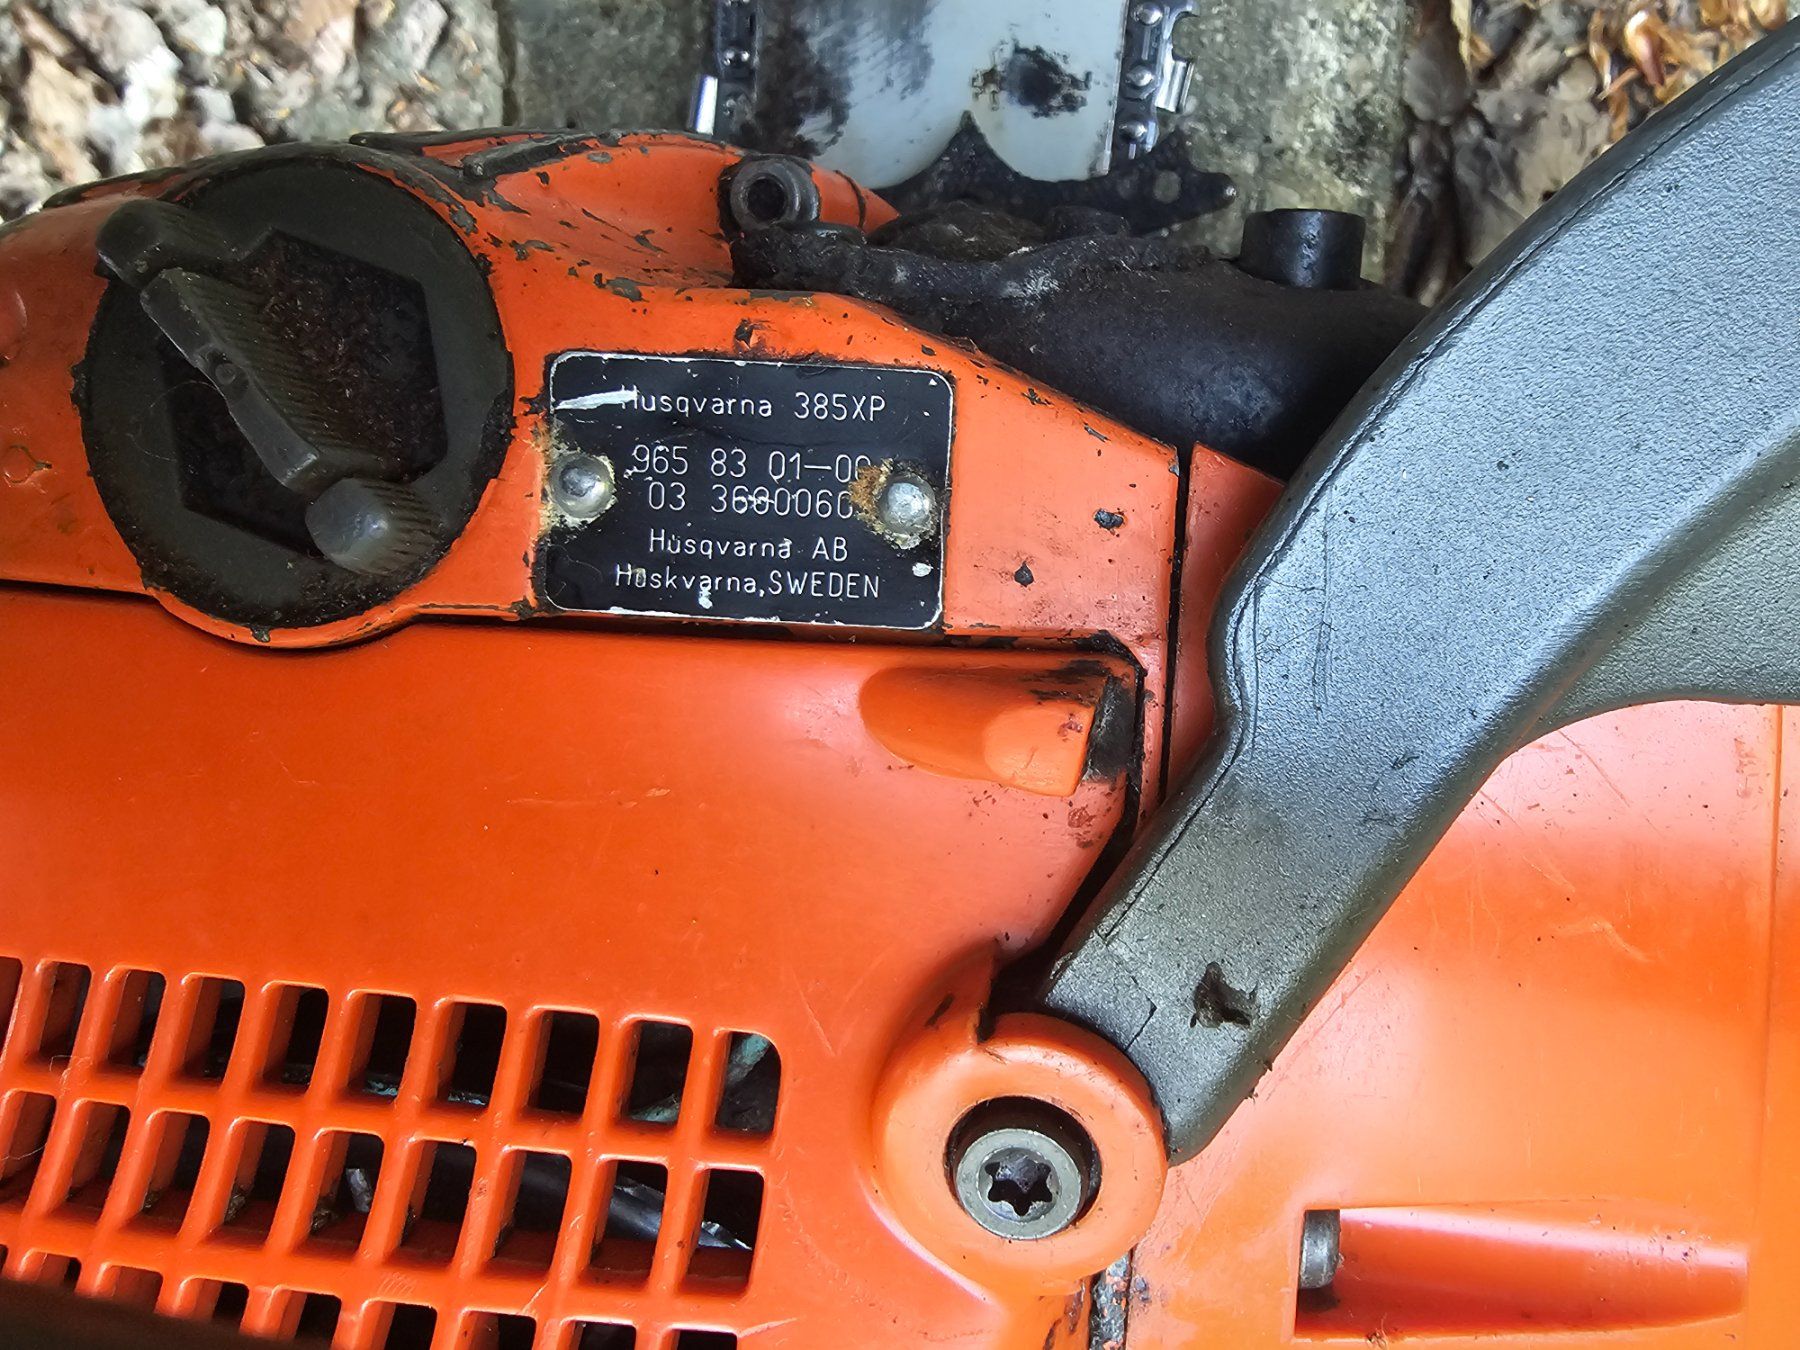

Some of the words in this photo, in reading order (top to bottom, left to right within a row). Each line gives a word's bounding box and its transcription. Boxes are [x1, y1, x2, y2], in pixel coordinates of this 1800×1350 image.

[794, 391, 886, 422] 385XP
[631, 444, 689, 475] 965
[710, 447, 747, 478] 83
[648, 481, 687, 511] 03
[649, 528, 792, 560] Husqvarna
[811, 536, 848, 562] AB
